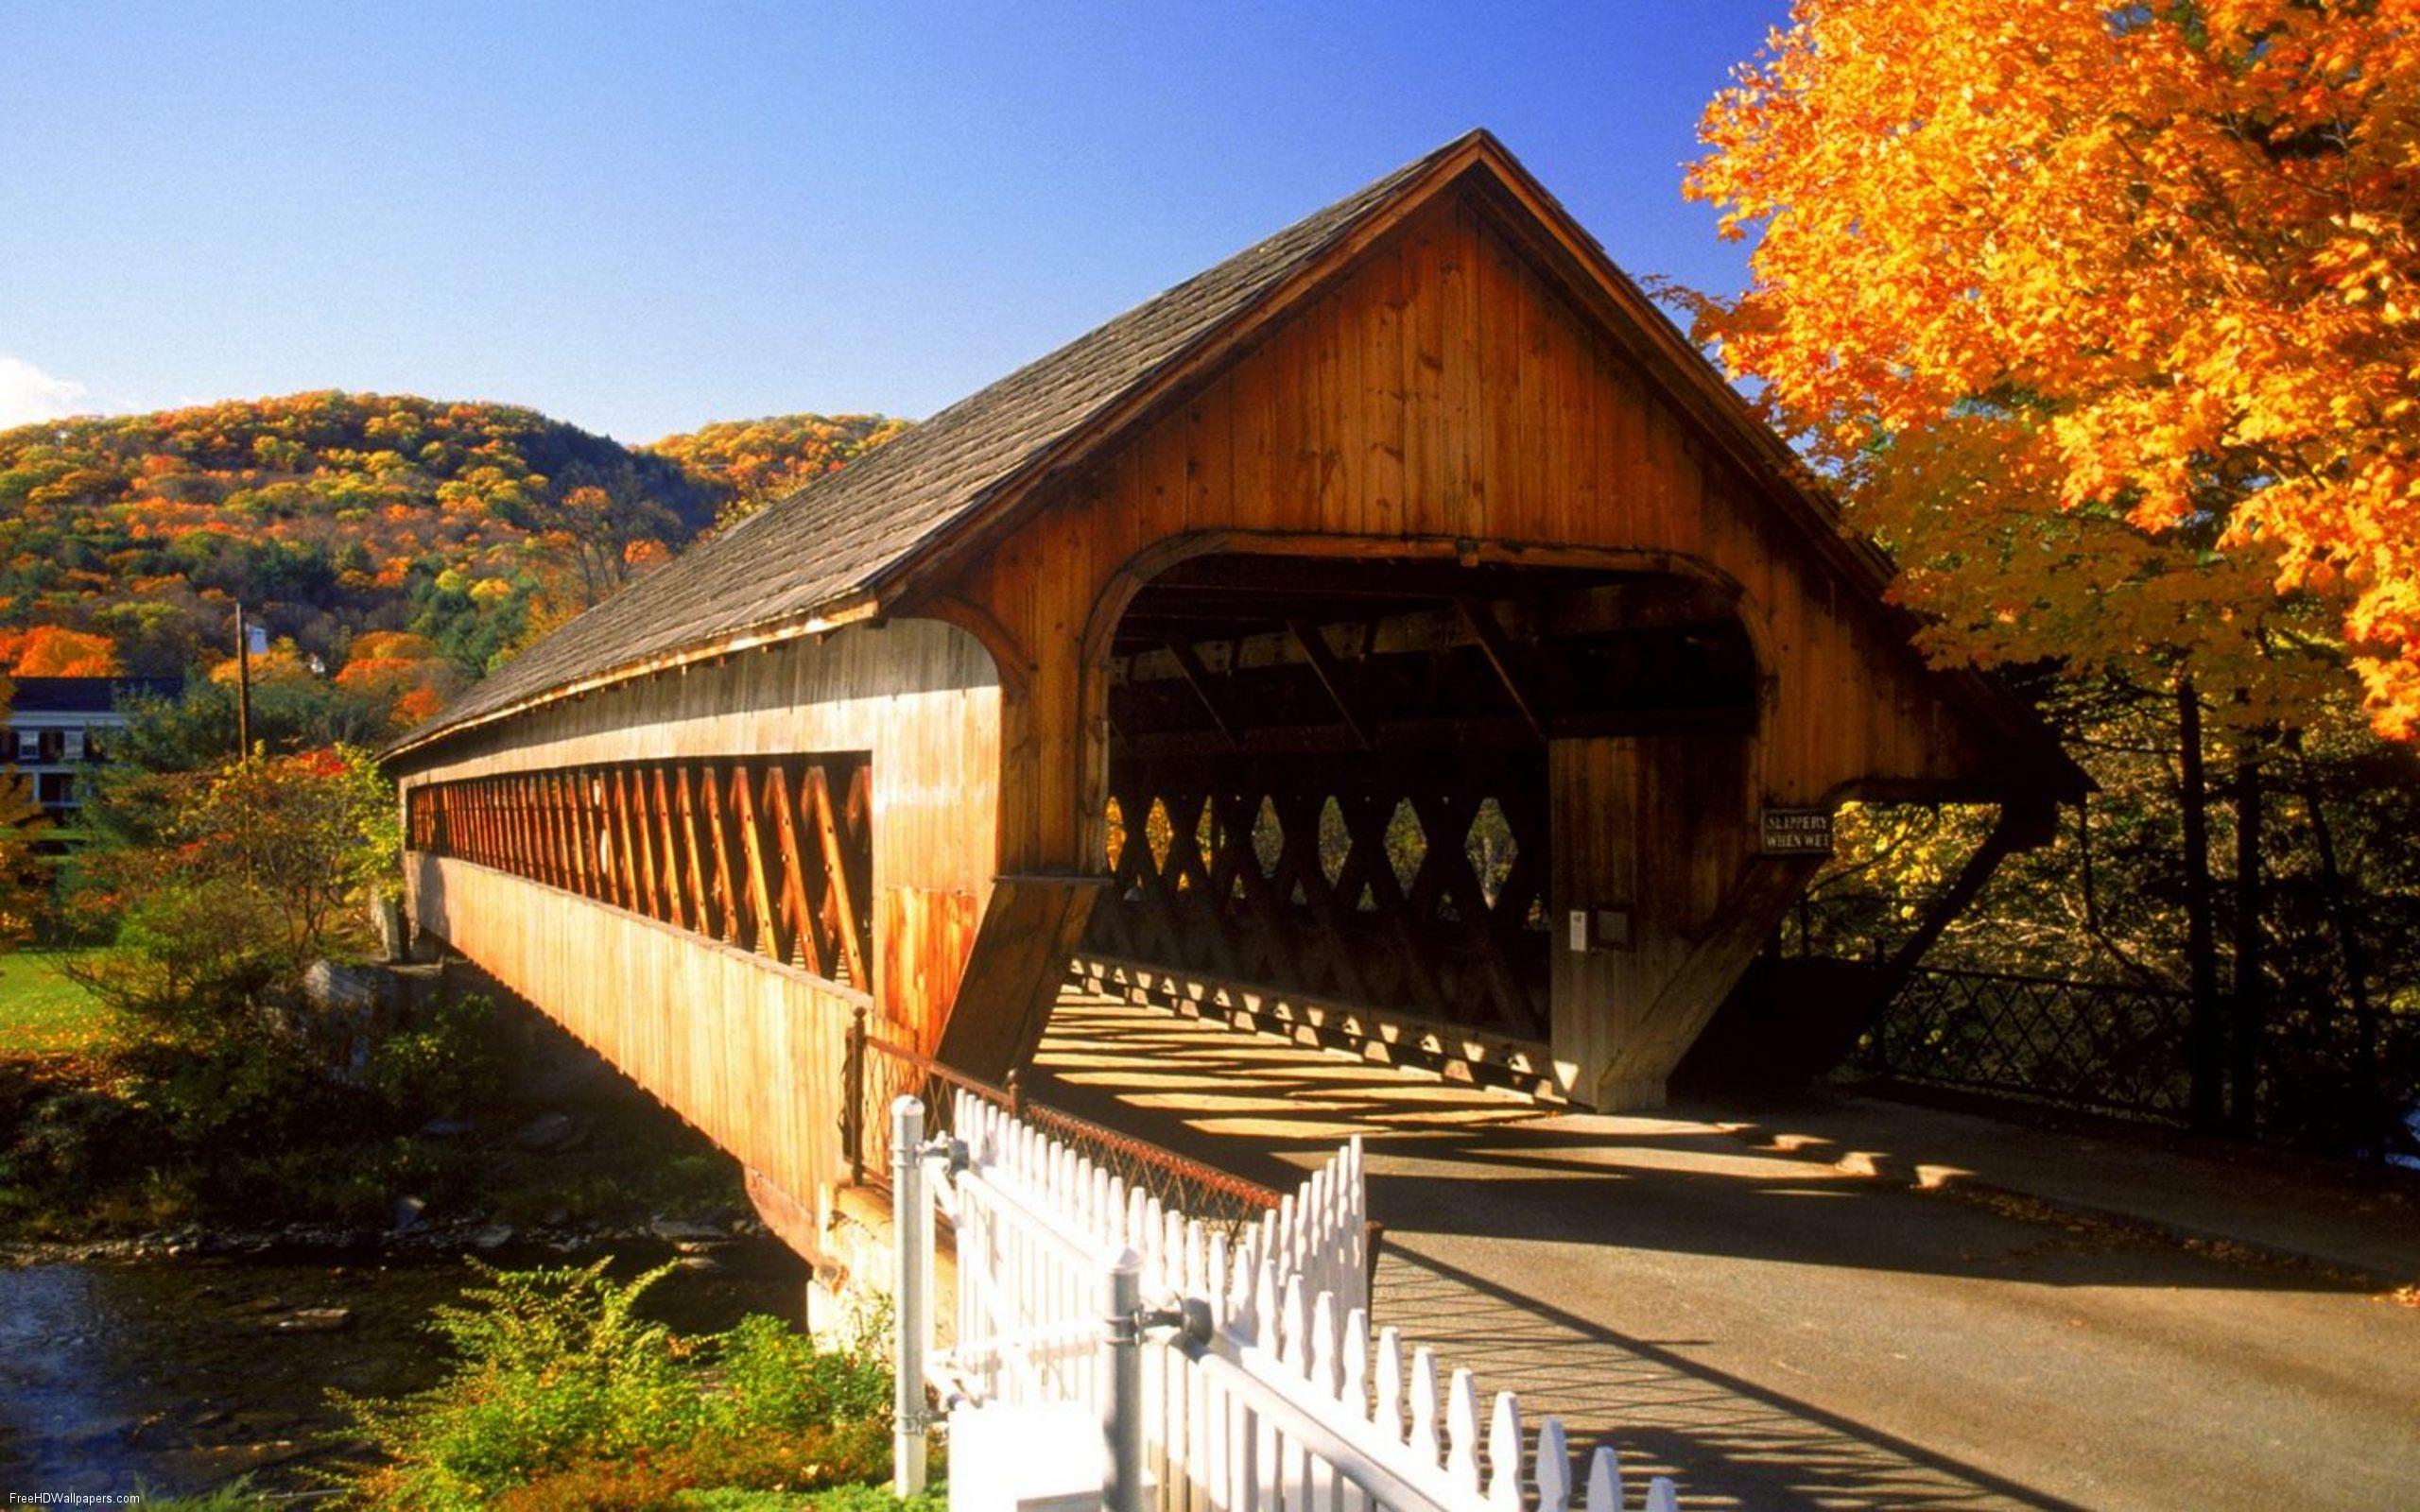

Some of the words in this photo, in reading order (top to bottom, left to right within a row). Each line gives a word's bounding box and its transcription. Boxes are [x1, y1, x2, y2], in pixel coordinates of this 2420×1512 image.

[1768, 816, 1827, 830] SLIPPERY
[1766, 833, 1802, 848] WHEN
[1804, 833, 1830, 848] WET
